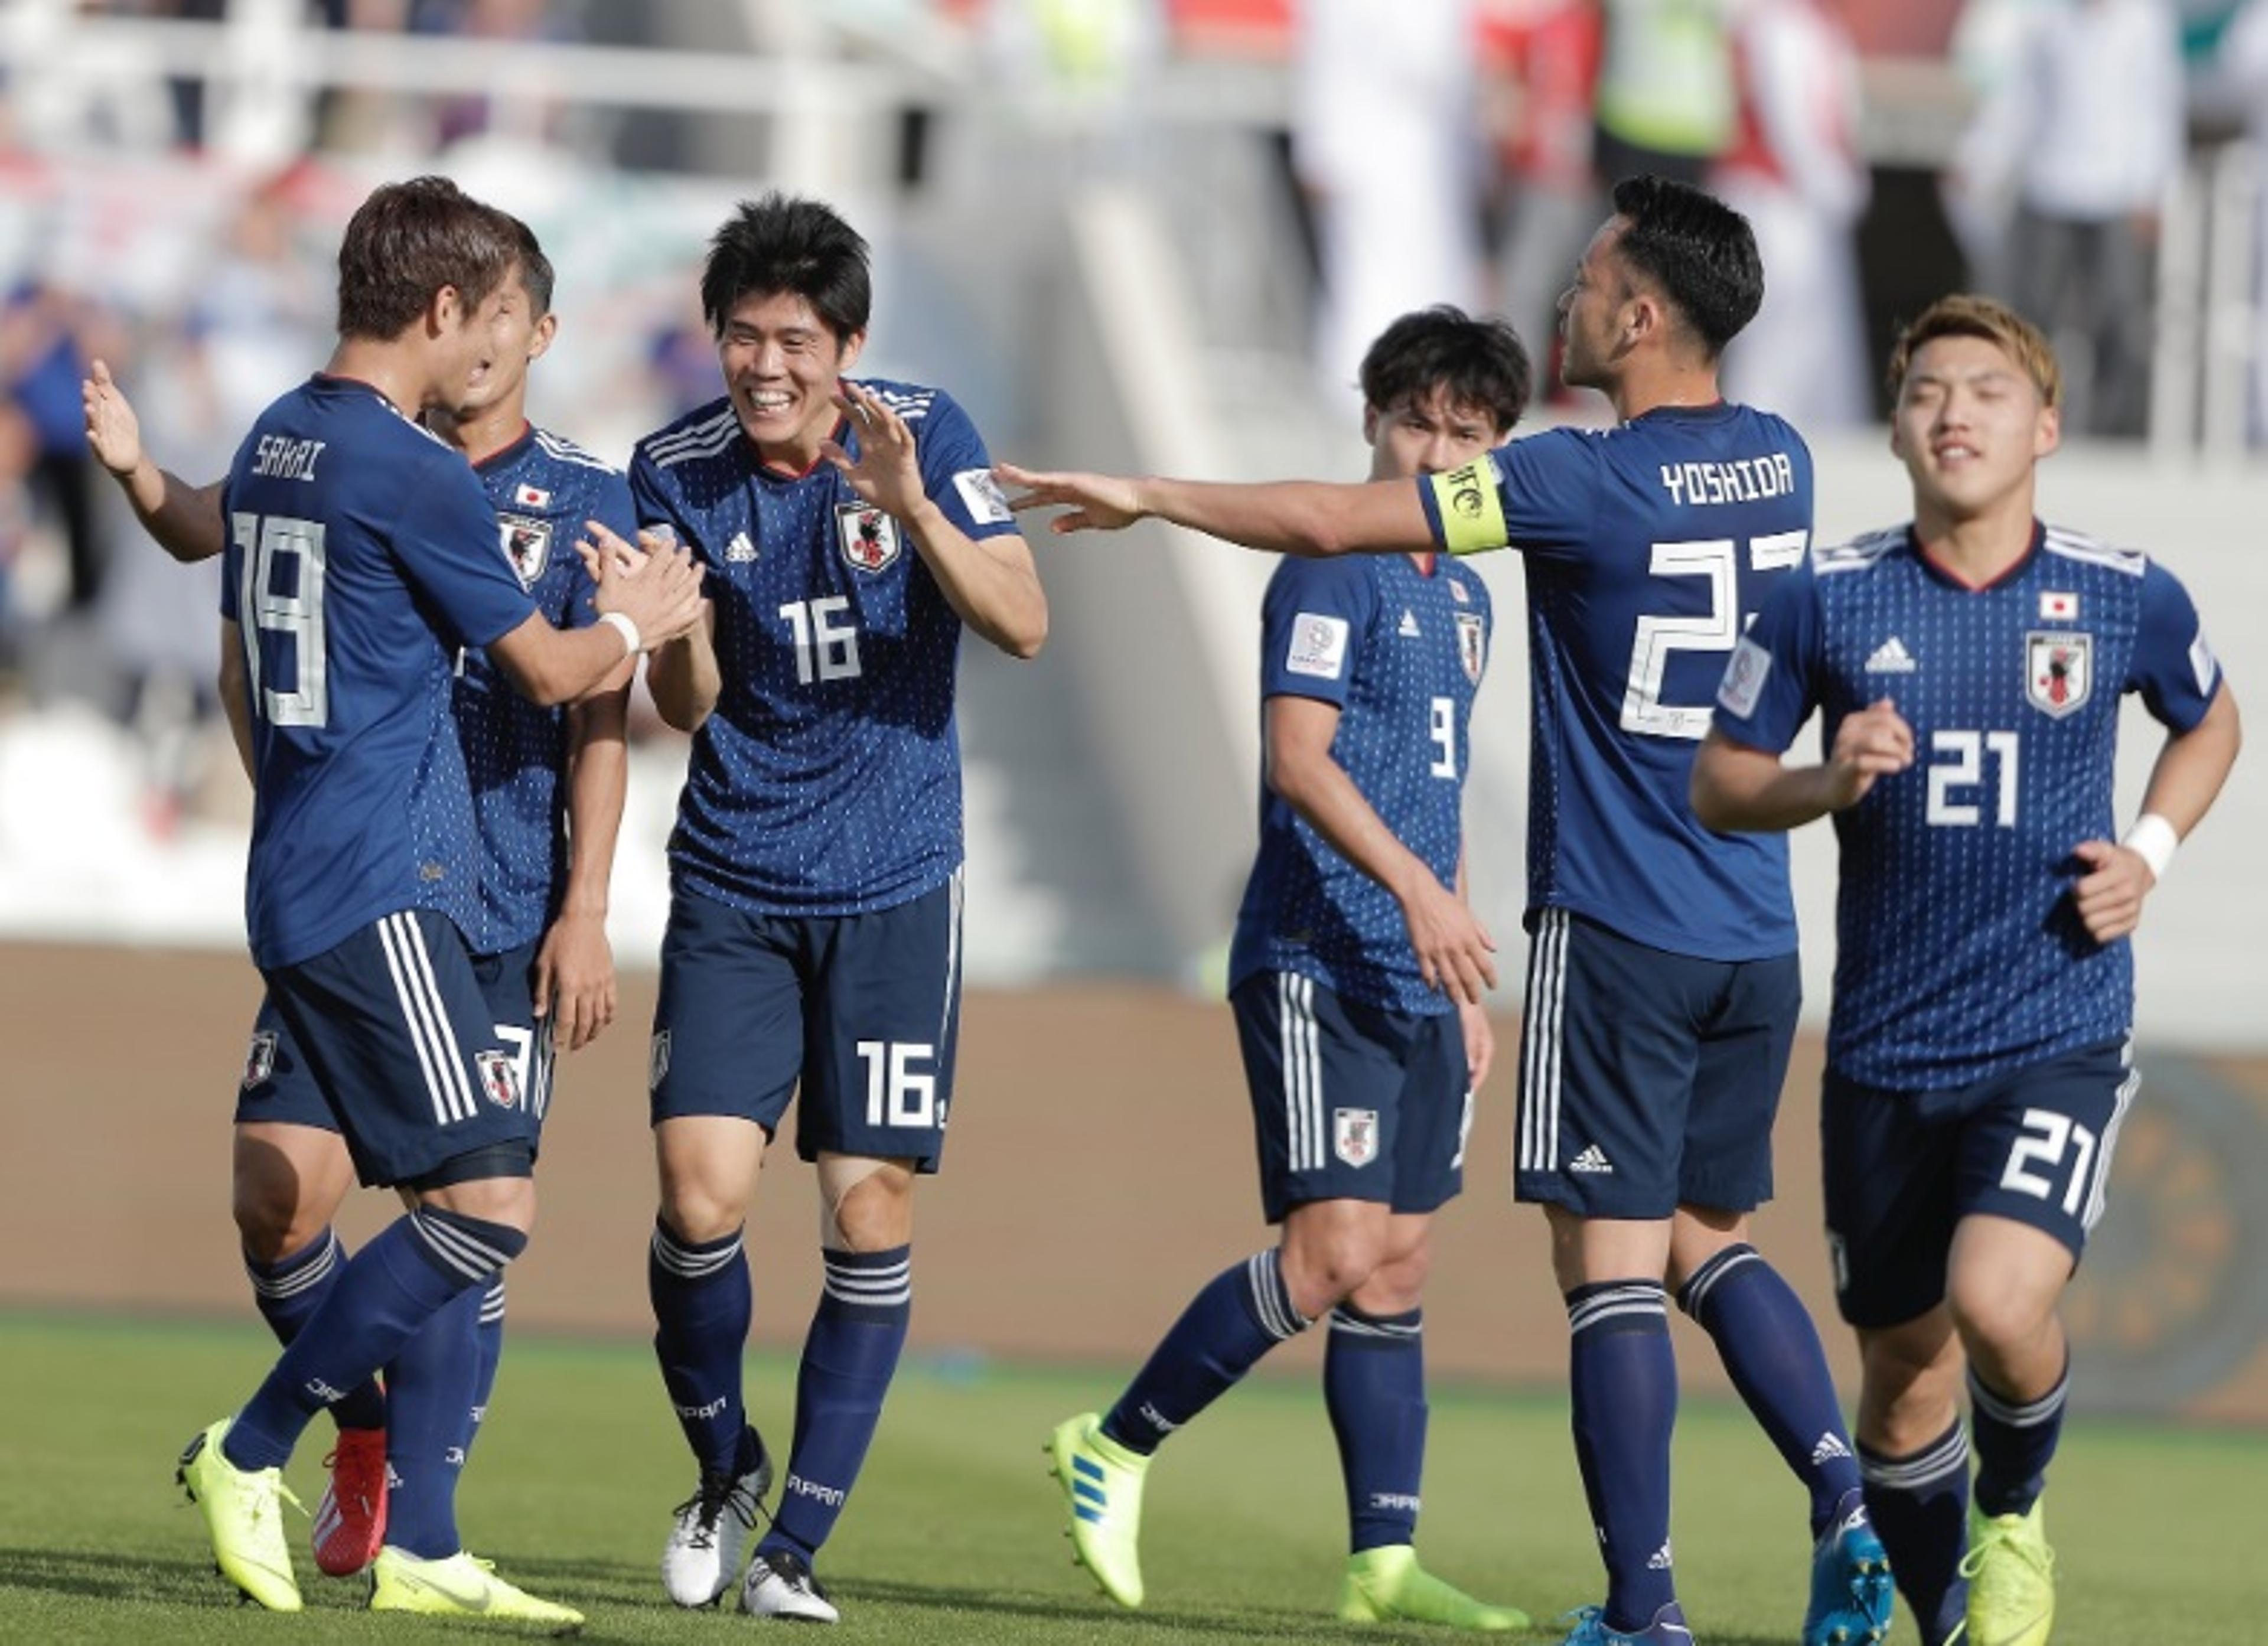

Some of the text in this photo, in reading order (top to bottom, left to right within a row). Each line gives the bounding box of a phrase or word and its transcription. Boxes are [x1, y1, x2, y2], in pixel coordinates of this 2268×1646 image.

[252, 434, 326, 482] SAKAI
[1660, 453, 1794, 504] YOSHIDA
[232, 511, 327, 728] 19
[779, 595, 862, 686] 16
[1619, 529, 1808, 741] 2
[1430, 697, 1455, 778] 9
[1927, 729, 2019, 827] 21
[856, 1041, 935, 1127] 16
[2000, 1108, 2096, 1215] 21
